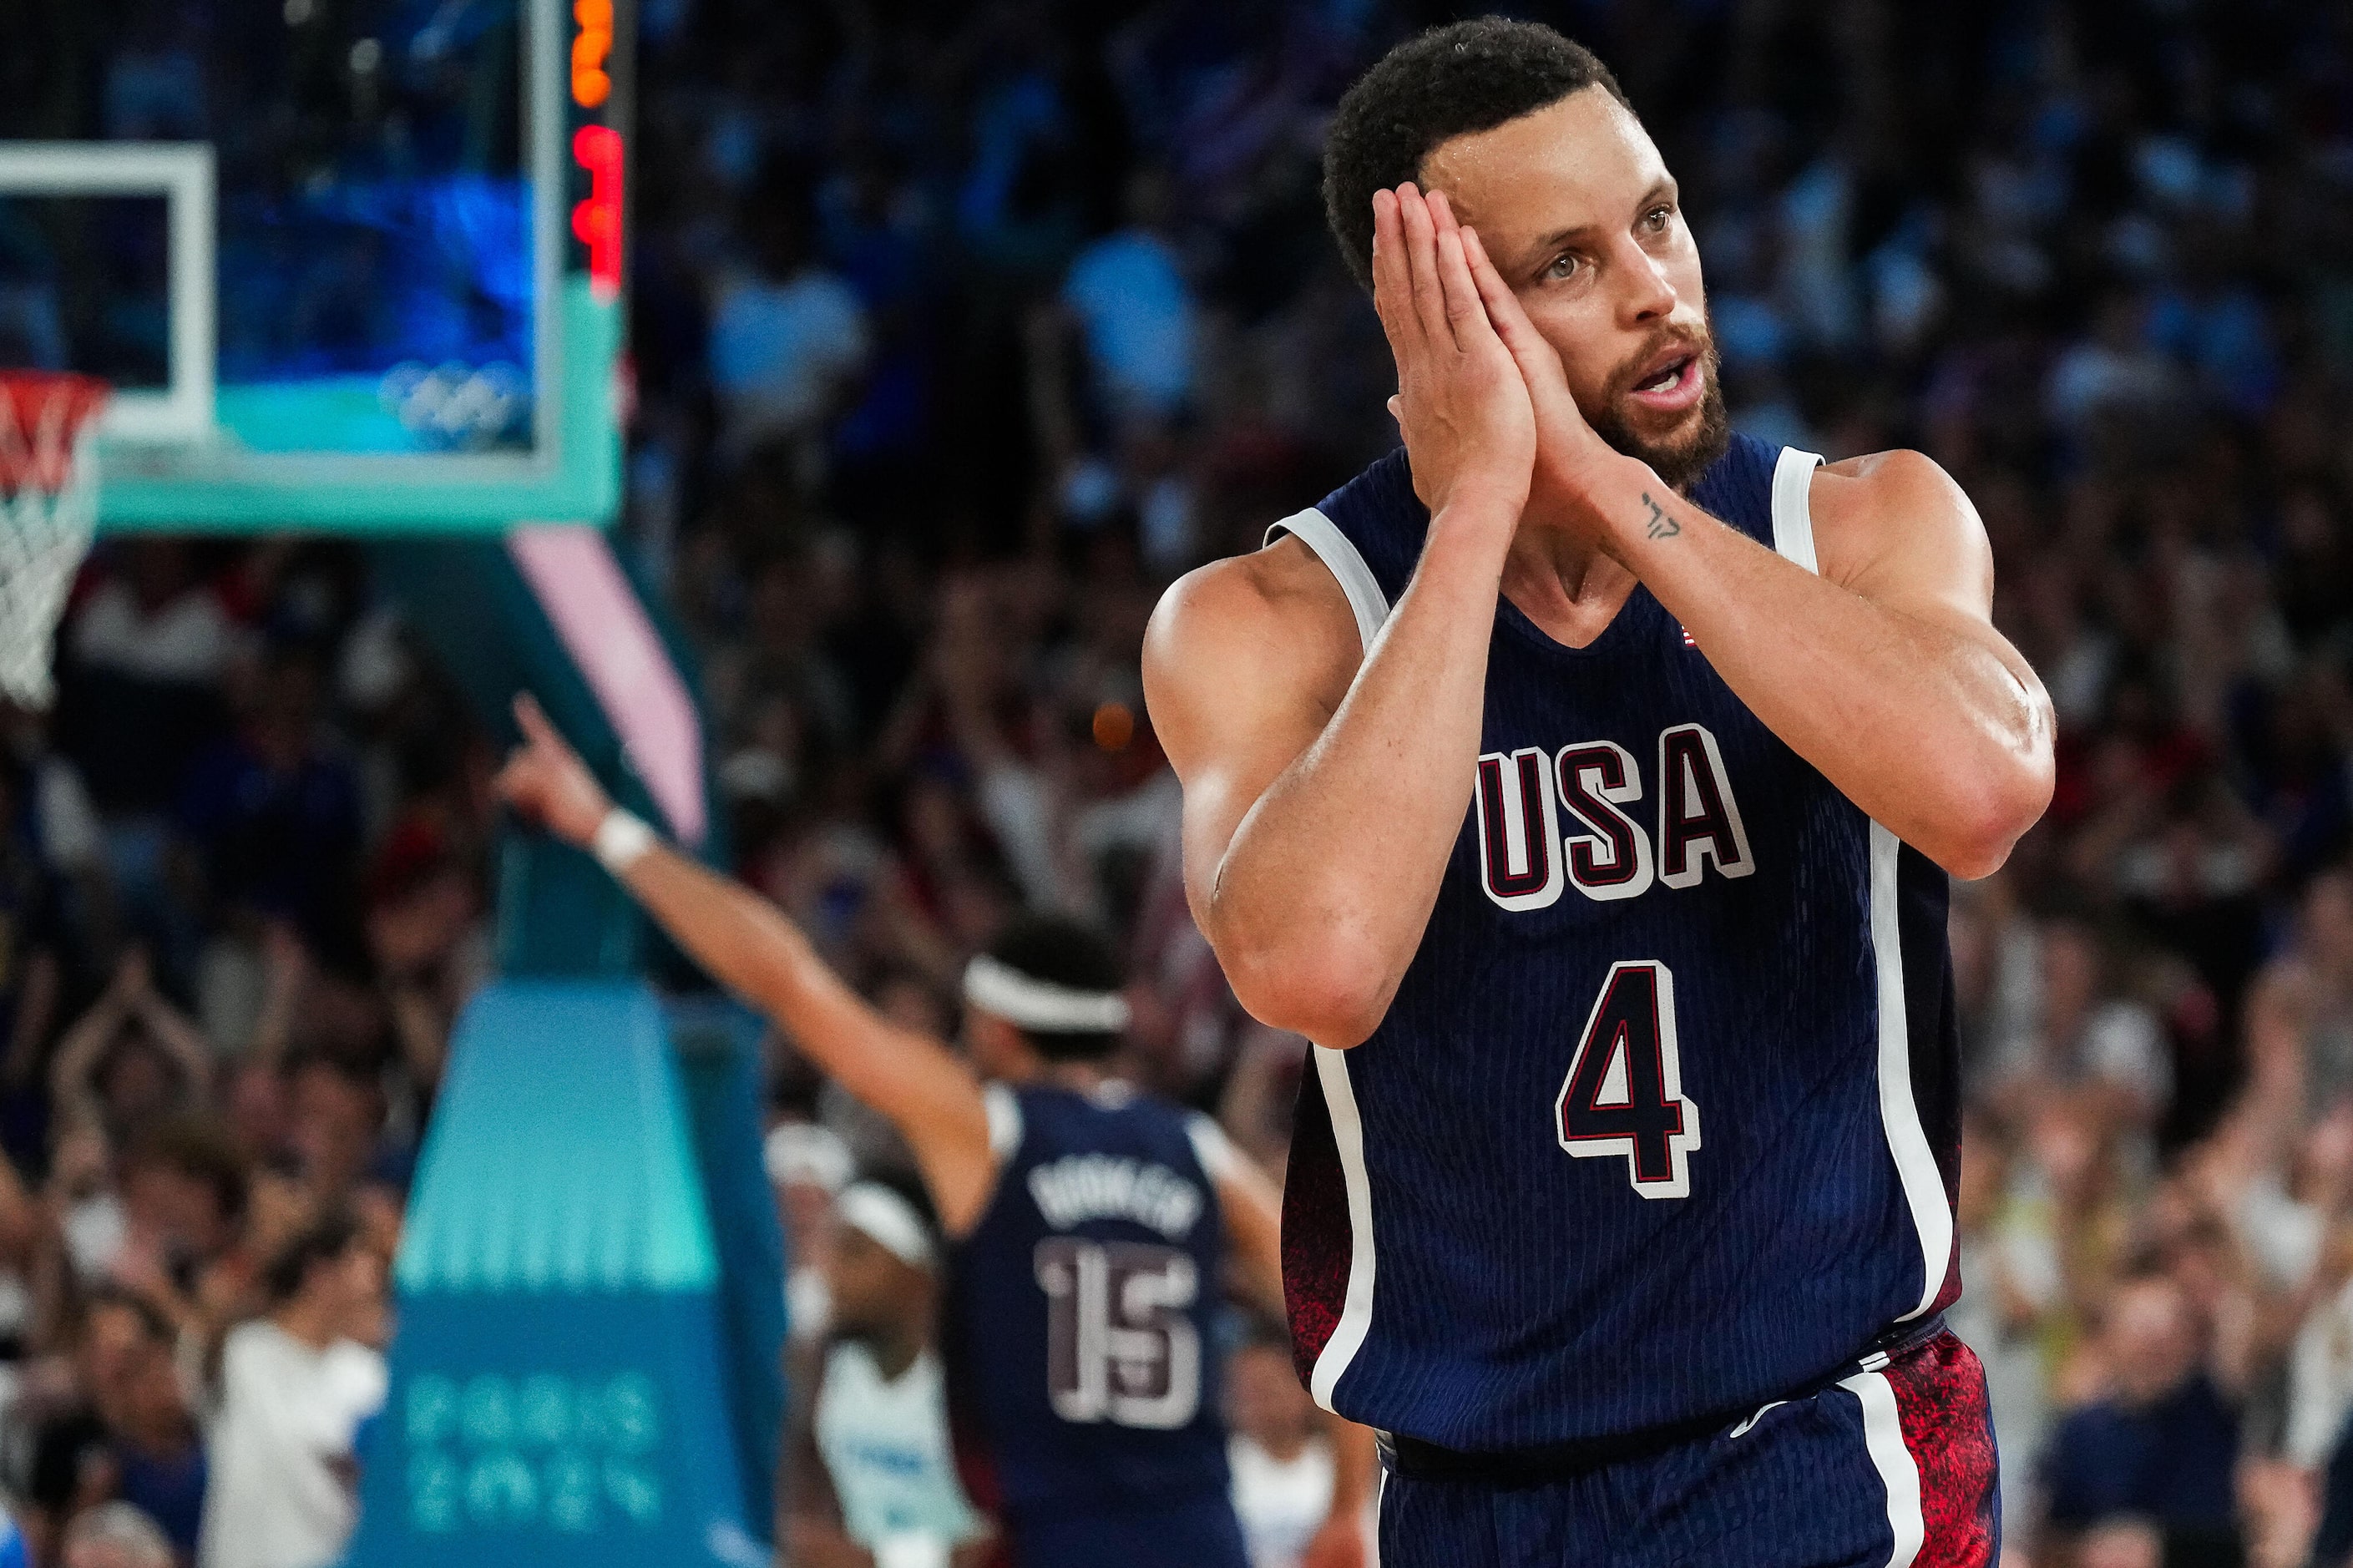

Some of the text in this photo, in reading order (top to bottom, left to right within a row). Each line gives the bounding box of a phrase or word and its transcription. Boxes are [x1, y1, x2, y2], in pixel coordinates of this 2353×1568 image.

[1476, 723, 1755, 912] USA
[1556, 960, 1701, 1199] 4
[1035, 1237, 1201, 1429] 15
